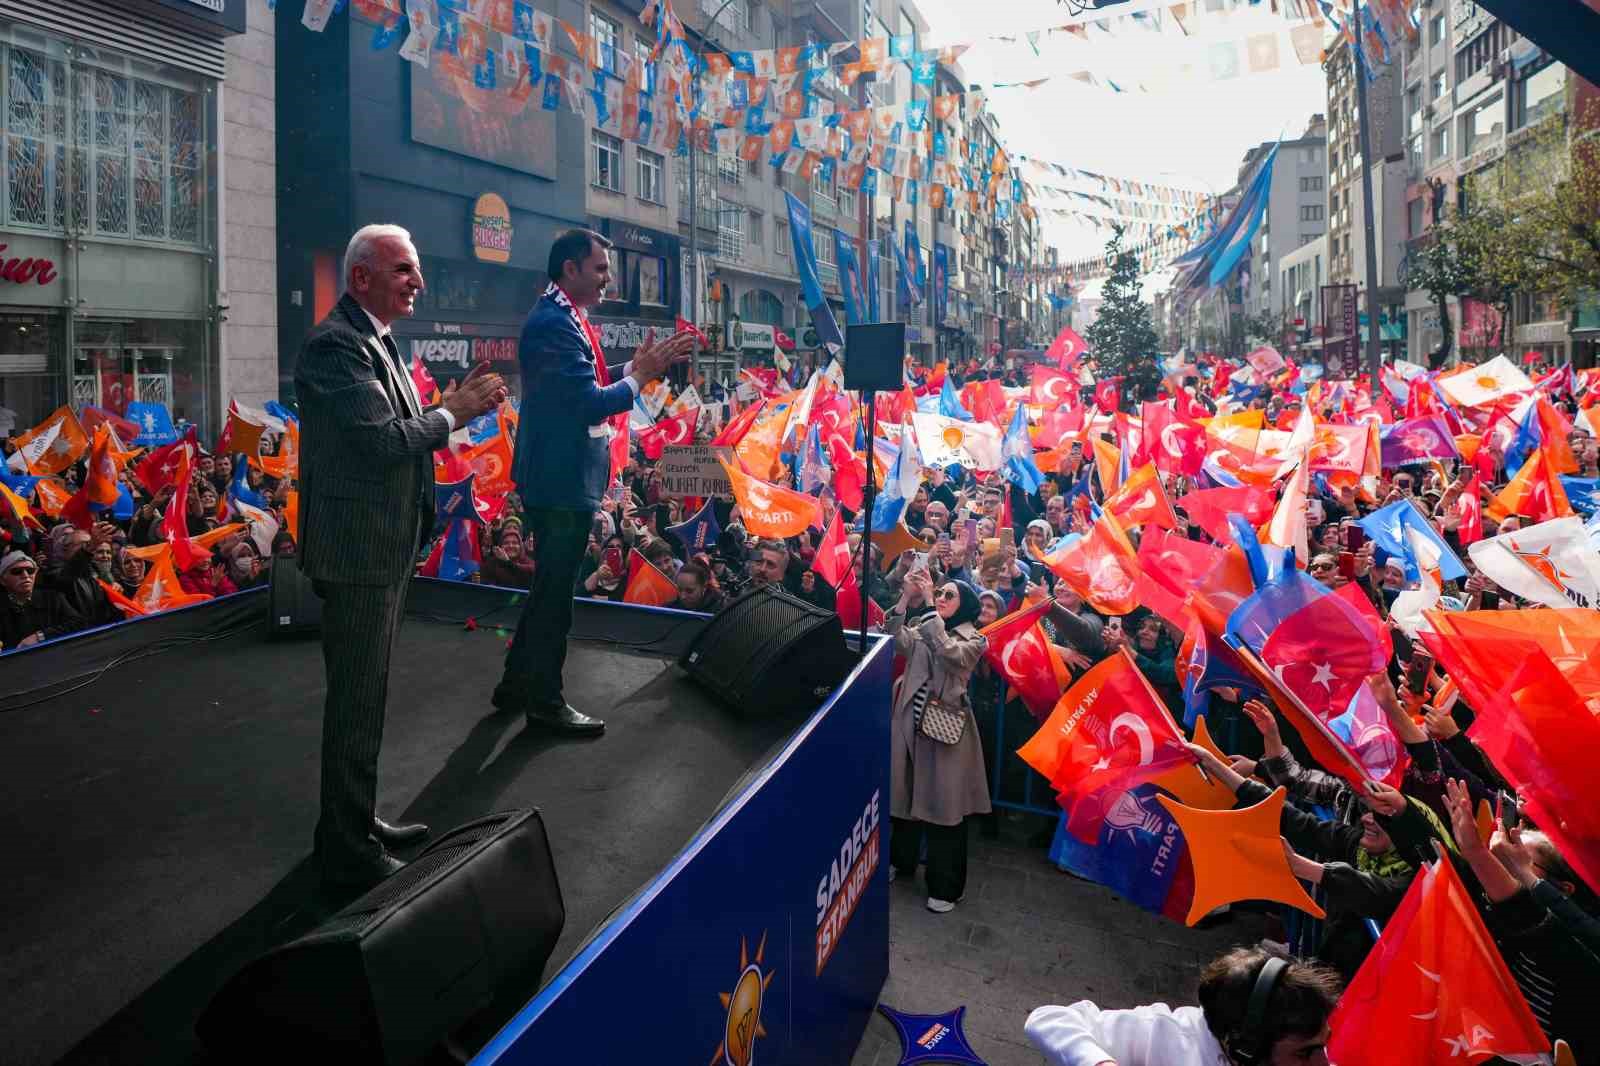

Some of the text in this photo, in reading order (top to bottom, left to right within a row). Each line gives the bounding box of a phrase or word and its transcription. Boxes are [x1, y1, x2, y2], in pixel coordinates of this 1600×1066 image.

[473, 225, 511, 249] BURGER
[473, 338, 516, 361] BURGER
[661, 477, 698, 493] MURAT
[1083, 687, 1098, 706] AK
[816, 788, 880, 926] SADECE
